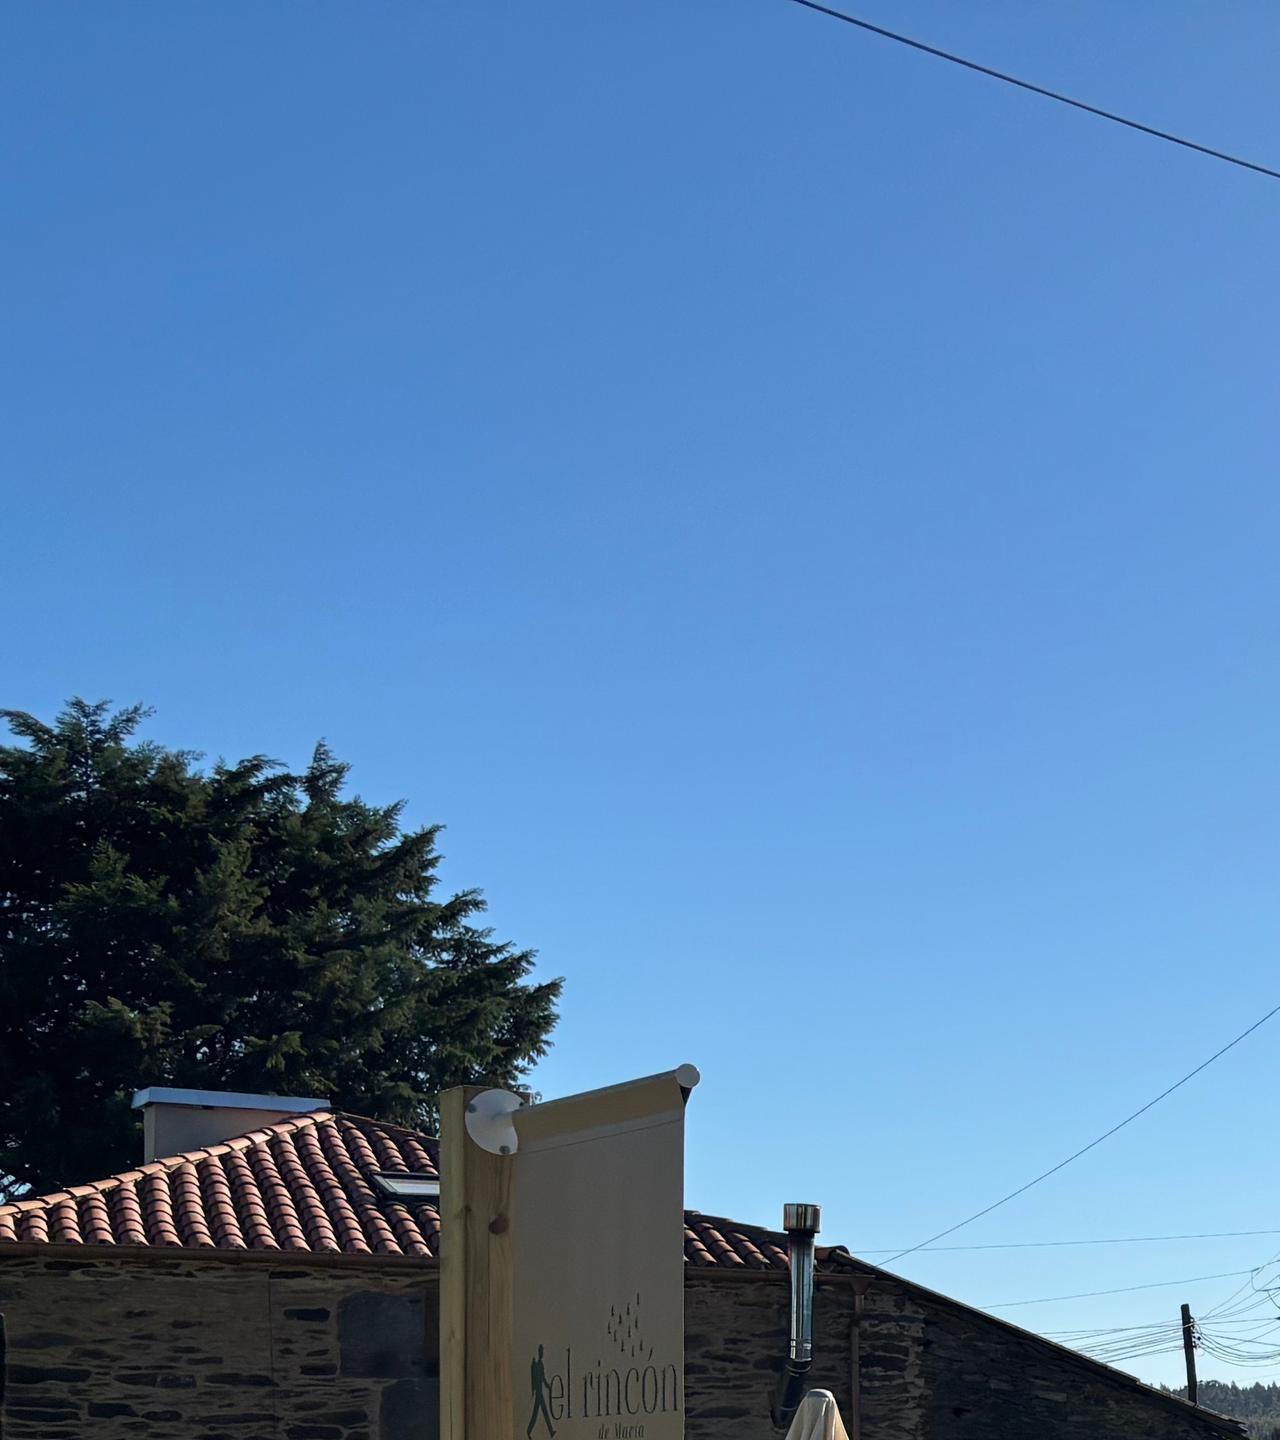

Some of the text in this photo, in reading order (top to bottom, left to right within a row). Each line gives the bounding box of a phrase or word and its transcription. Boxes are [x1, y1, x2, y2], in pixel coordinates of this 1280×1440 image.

[549, 1344, 679, 1421] el rincón
[598, 1423, 610, 1440] de
